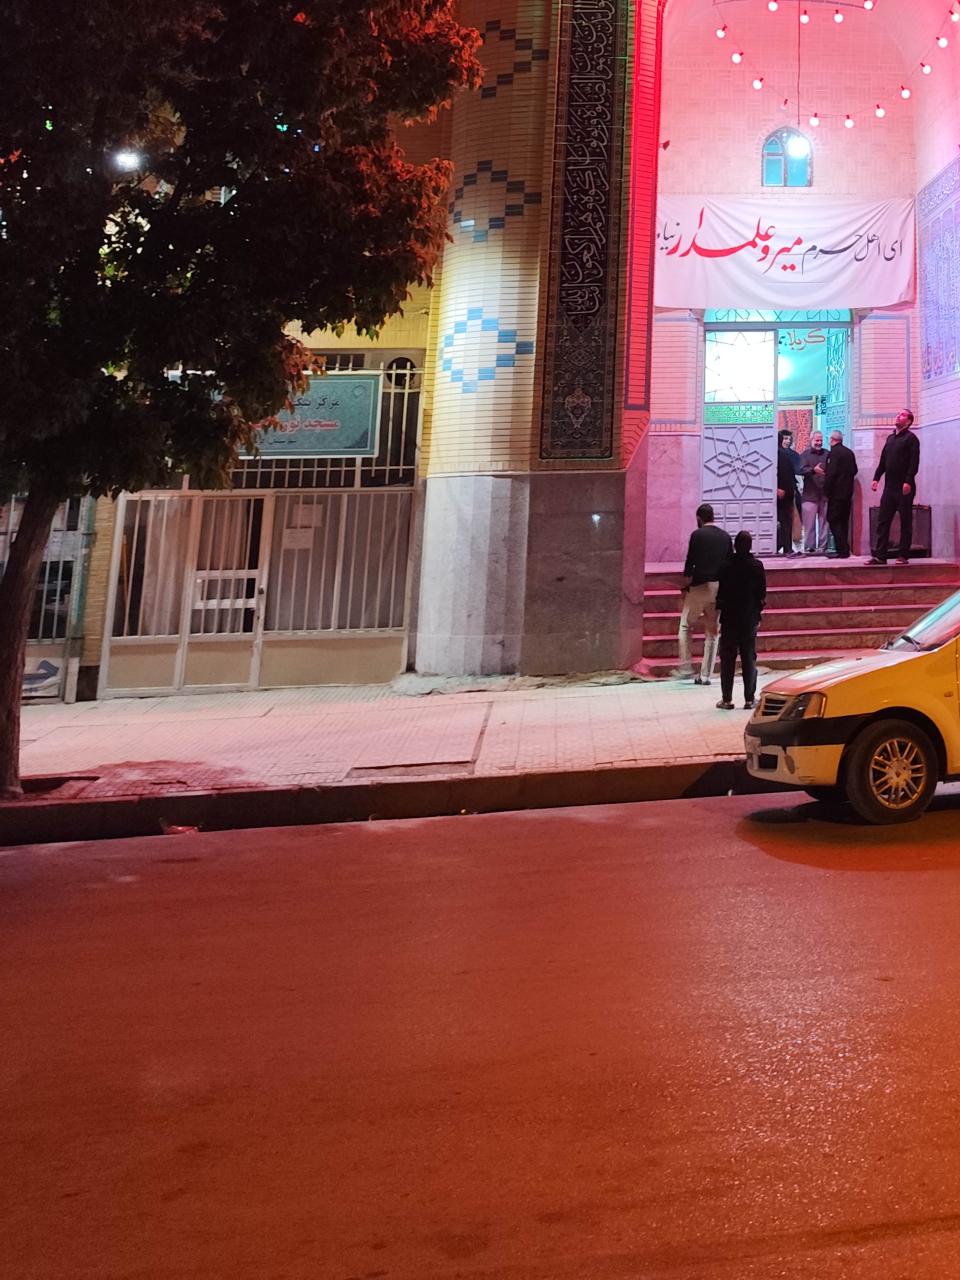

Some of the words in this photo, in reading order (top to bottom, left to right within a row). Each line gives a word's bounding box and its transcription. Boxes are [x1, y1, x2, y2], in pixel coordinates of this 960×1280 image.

[665, 207, 776, 258] علمدار
[756, 244, 770, 262] و
[762, 236, 803, 275] میر
[801, 234, 864, 276] حرم
[854, 232, 880, 262] اهل
[883, 239, 903, 262] ای
[788, 327, 826, 351] کربلا
[303, 418, 339, 431] مسجد
